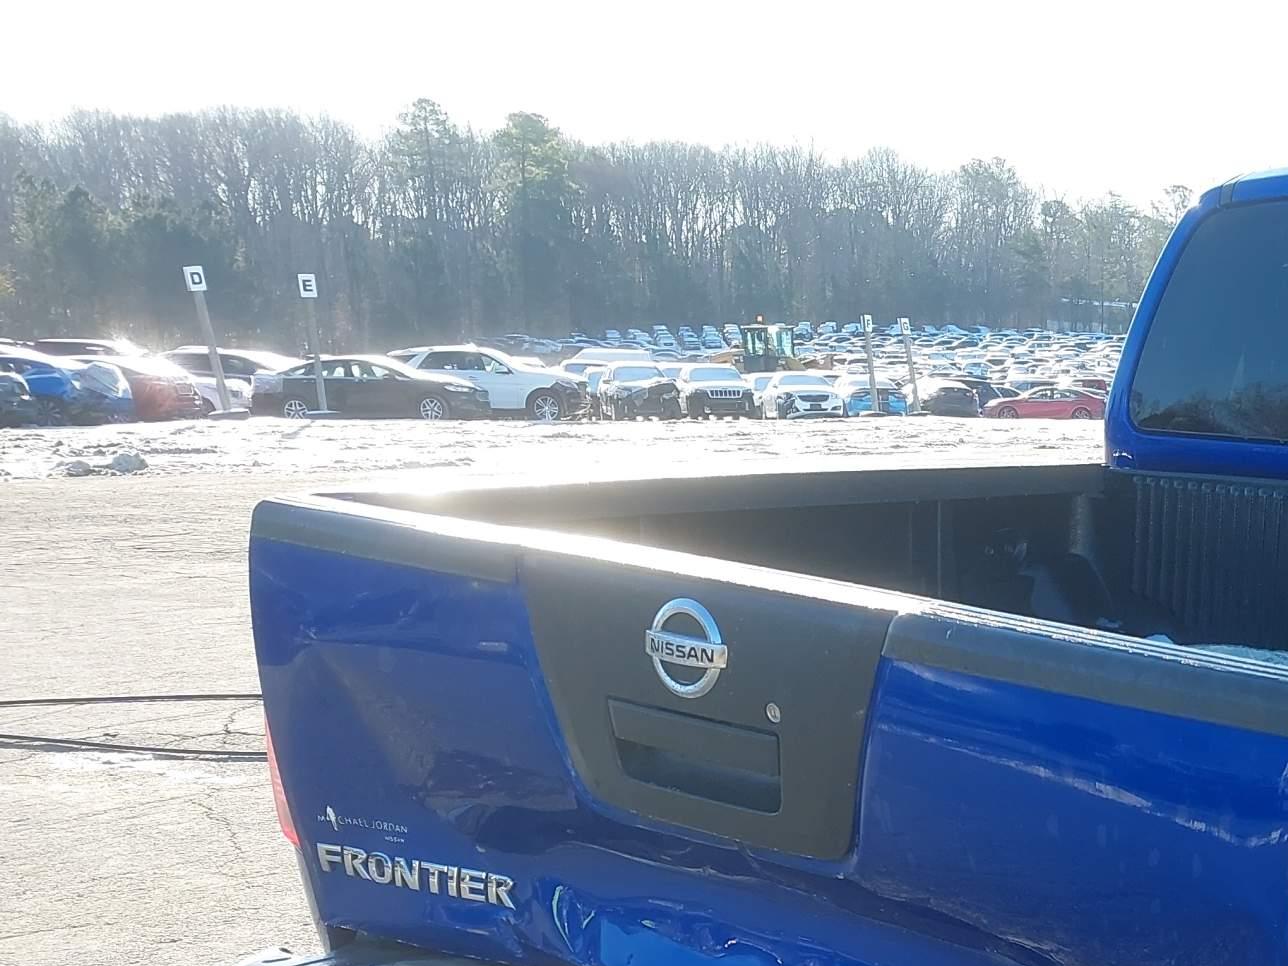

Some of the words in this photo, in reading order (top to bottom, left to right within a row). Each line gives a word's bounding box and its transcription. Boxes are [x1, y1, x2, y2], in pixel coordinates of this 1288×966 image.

[189, 271, 203, 285] D
[302, 279, 314, 292] E
[902, 321, 909, 331] G
[649, 638, 714, 664] NISSAN
[317, 811, 368, 829] MCHAEL
[370, 820, 408, 834] JORDAN
[316, 842, 517, 910] FRONTIER
